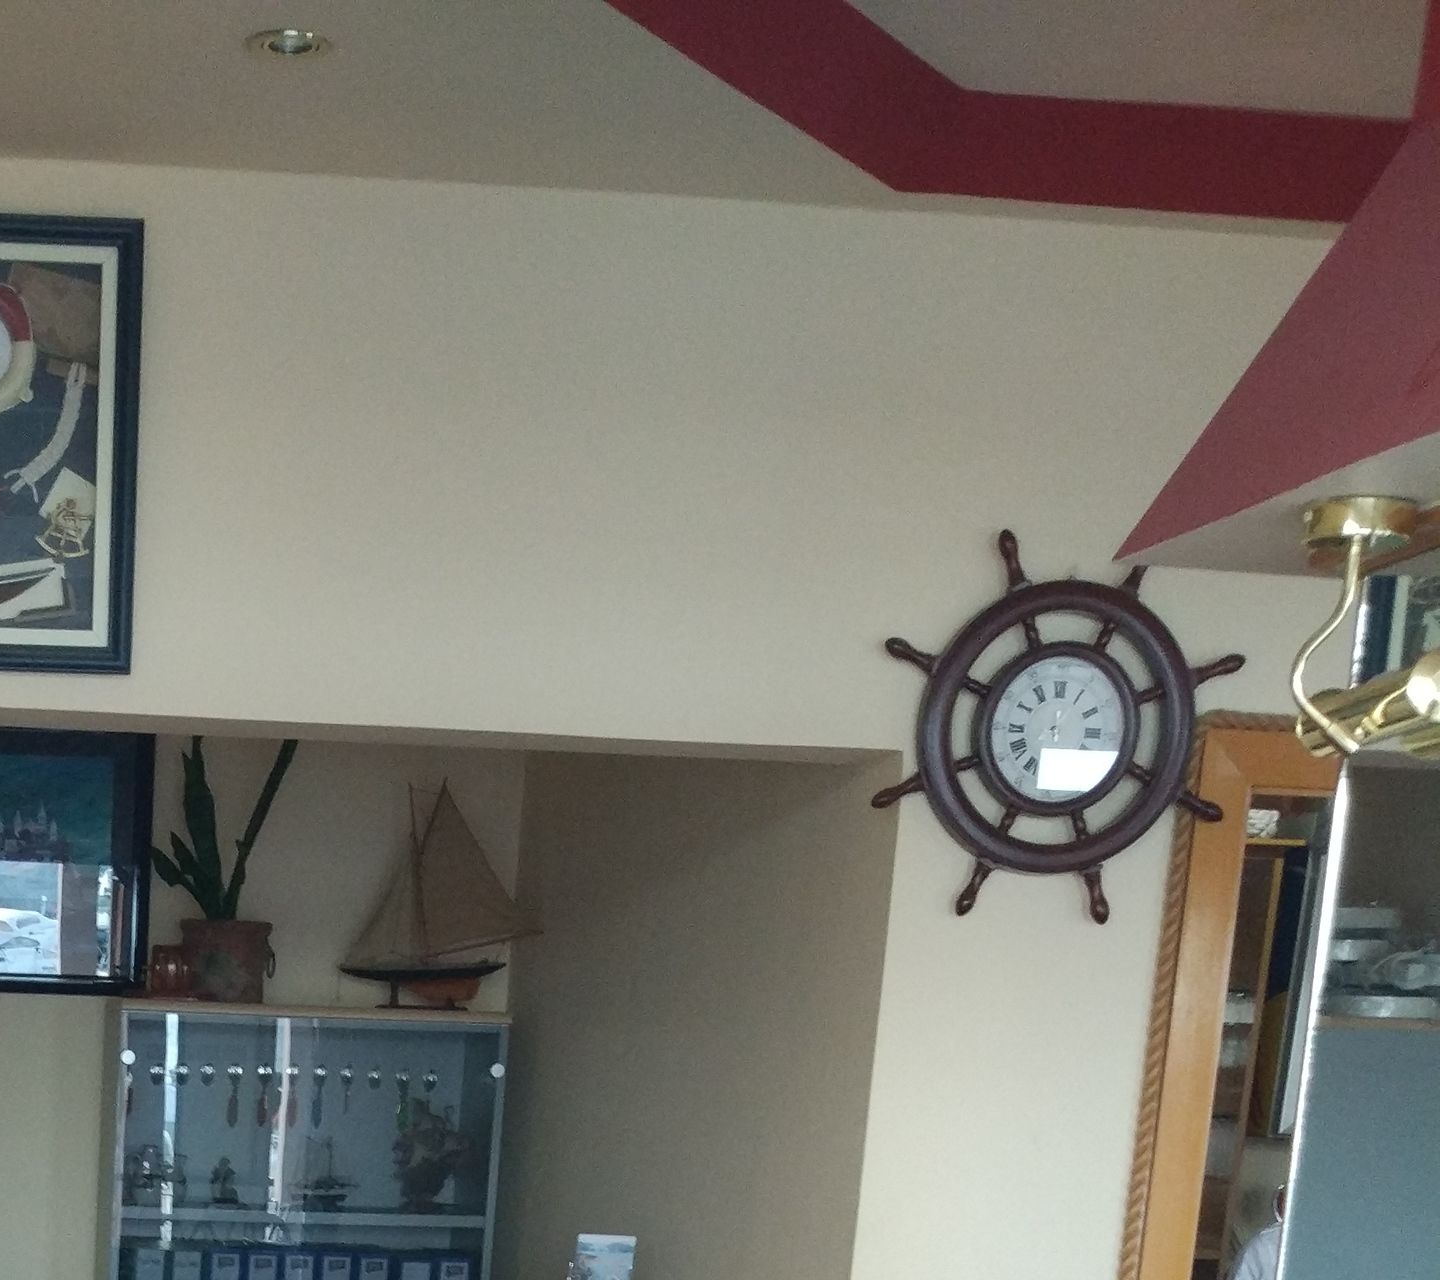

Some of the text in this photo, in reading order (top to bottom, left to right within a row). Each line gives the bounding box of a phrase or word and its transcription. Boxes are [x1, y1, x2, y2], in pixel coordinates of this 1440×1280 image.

[1073, 688, 1085, 705] I
[1081, 705, 1099, 720] II
[1083, 727, 1101, 740] III
